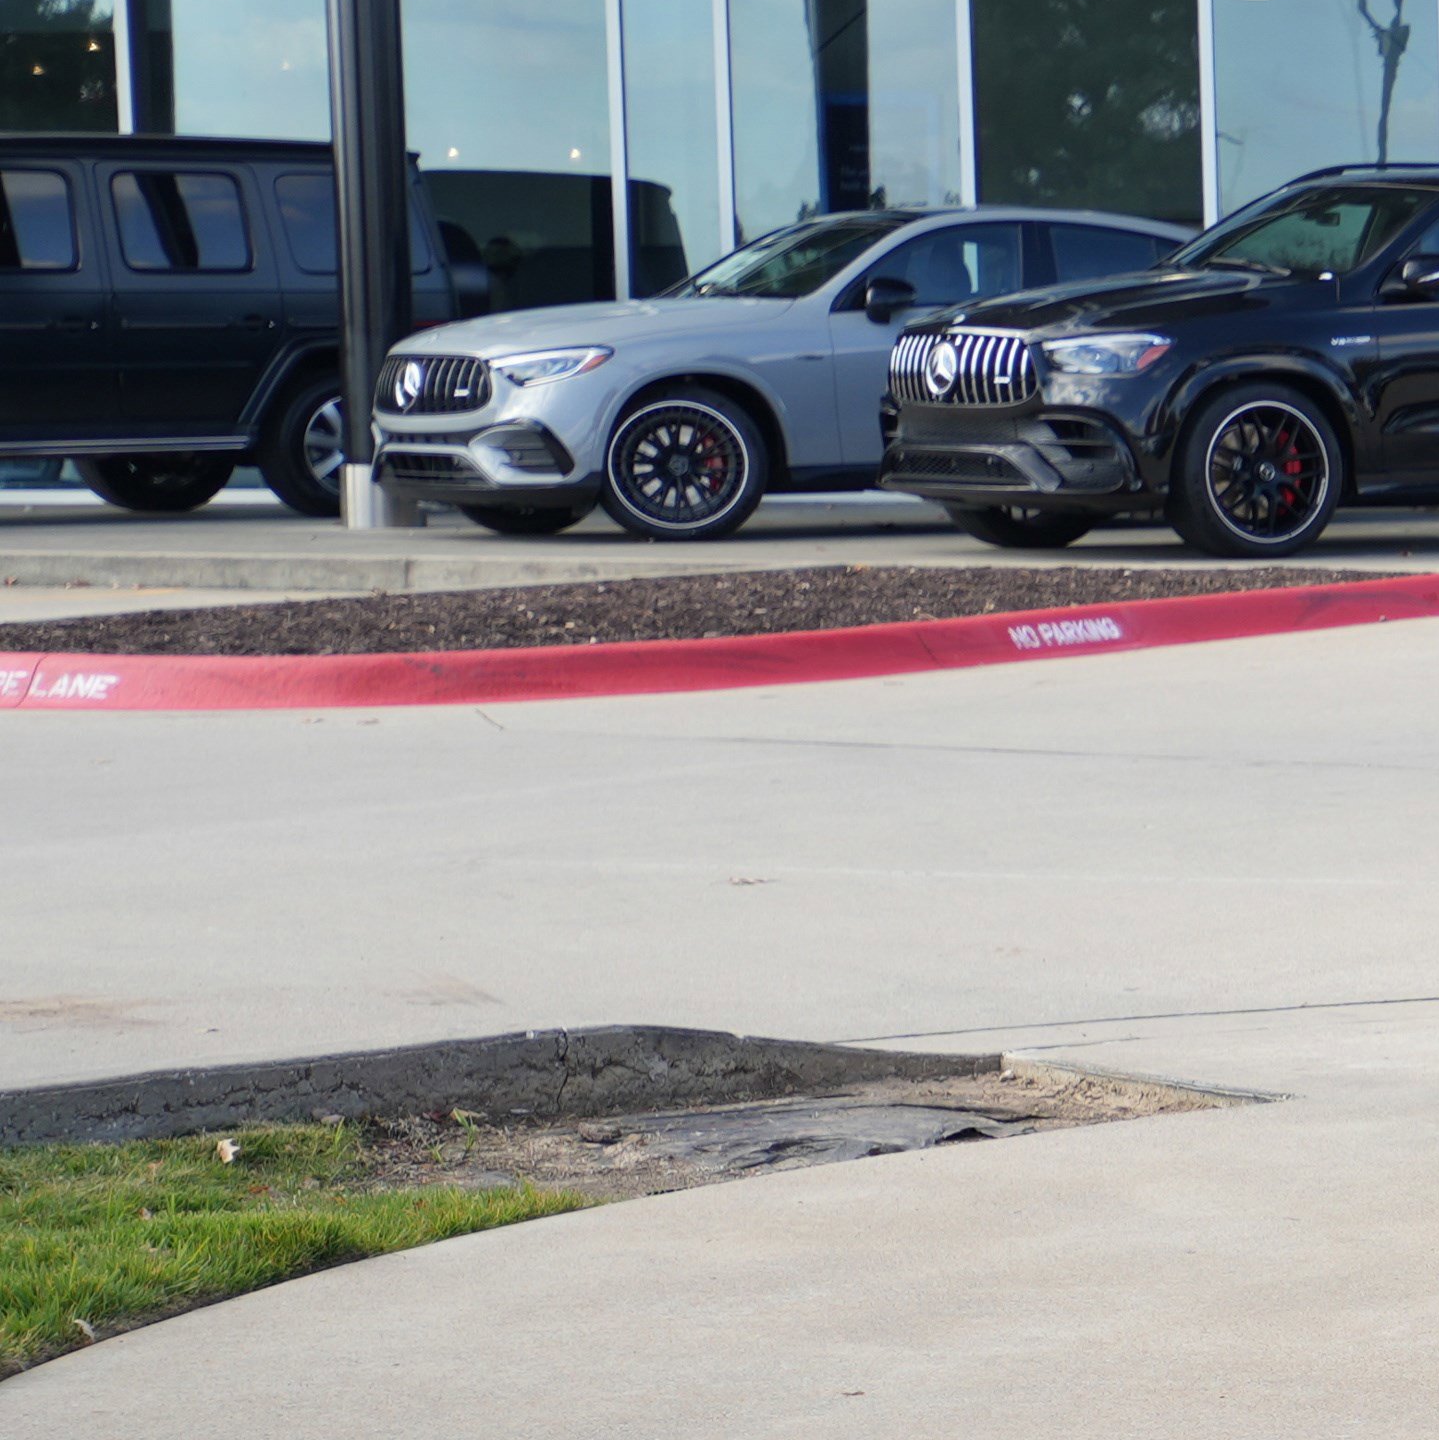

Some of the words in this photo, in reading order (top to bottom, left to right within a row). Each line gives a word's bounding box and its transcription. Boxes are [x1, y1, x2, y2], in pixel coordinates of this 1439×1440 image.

[1007, 624, 1039, 650] NO
[1038, 617, 1122, 647] PARKING
[29, 671, 119, 700] LANE
